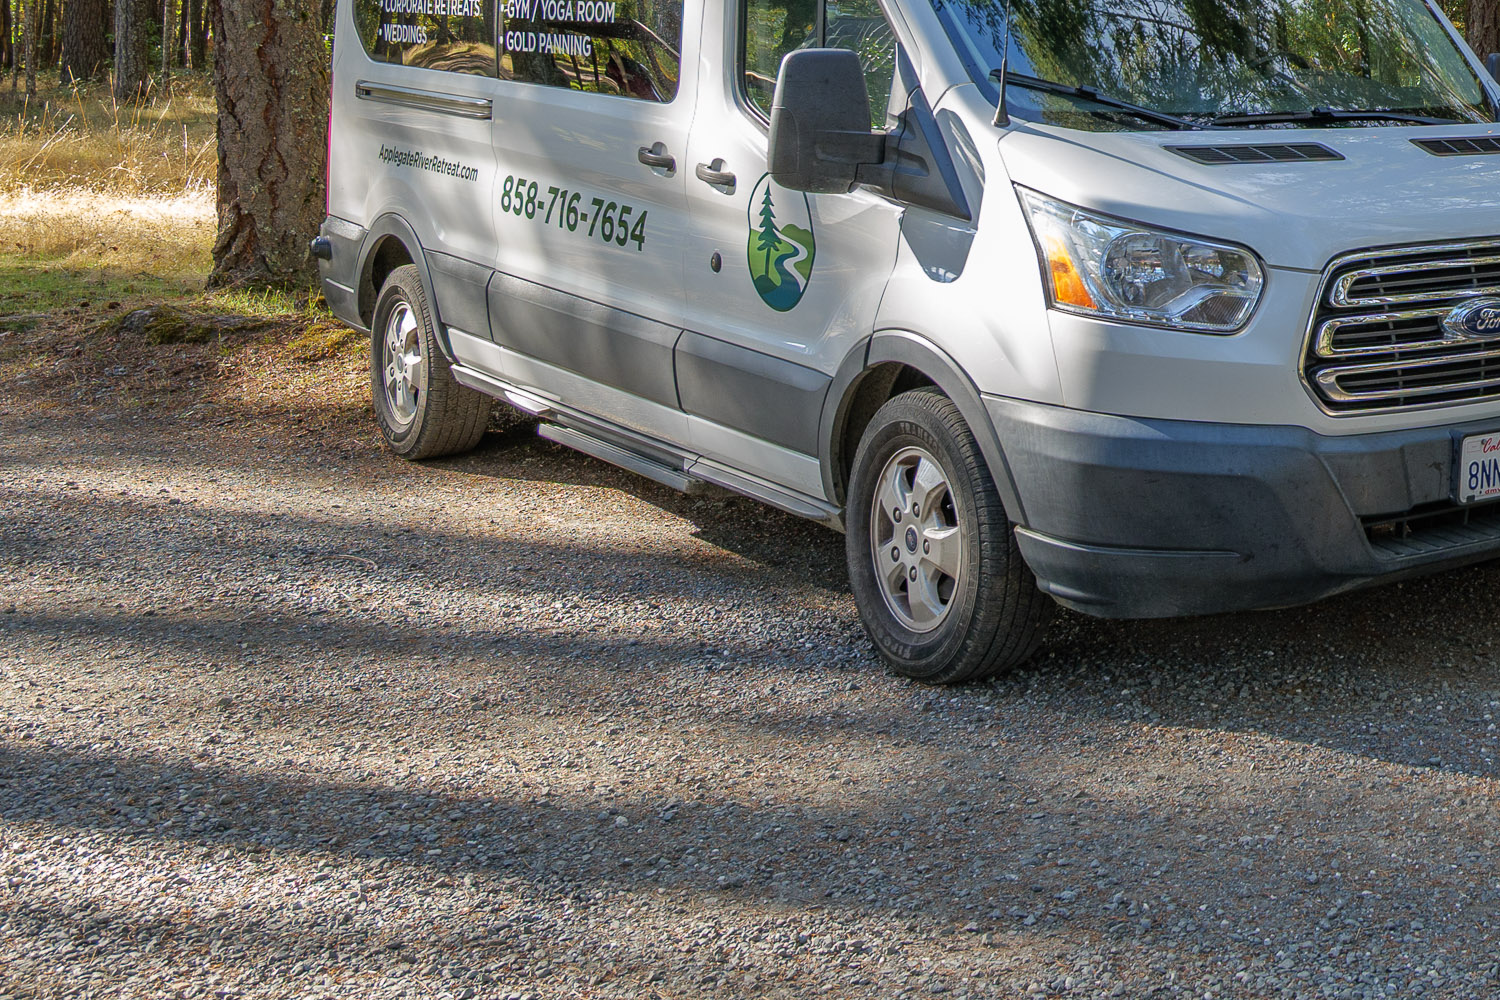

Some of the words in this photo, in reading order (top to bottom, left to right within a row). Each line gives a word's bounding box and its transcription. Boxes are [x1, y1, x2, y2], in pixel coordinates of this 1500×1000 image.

[541, 0, 573, 21] YOGA
[576, 1, 616, 23] ROOM
[383, 24, 427, 44] WEDDINGS
[506, 31, 537, 51] GOLD
[539, 33, 592, 57] PANNING
[378, 144, 479, 182] ApplegateRiverRetreat.com
[500, 175, 648, 251] 858-716-7654
